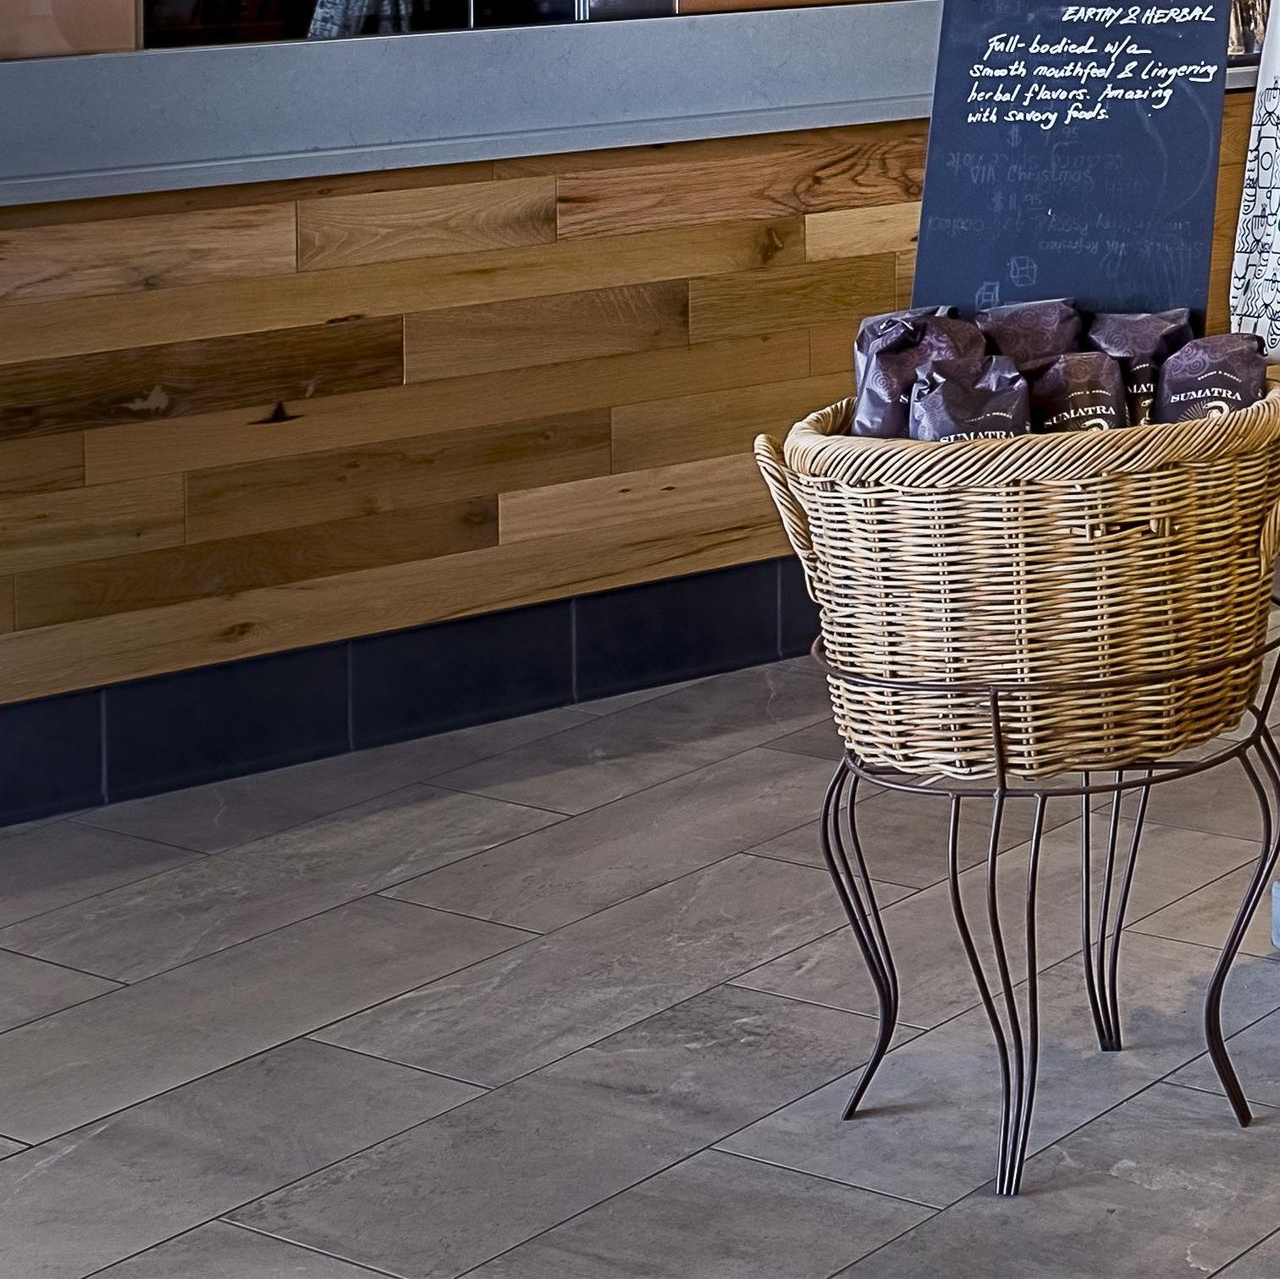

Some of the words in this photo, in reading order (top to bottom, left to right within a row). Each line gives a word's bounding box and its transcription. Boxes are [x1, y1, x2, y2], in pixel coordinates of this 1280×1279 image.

[1062, 5, 1123, 27] EARTHY
[1120, 6, 1137, 24] &
[1141, 5, 1216, 25] HERBAL
[983, 34, 1097, 61] Full-bodied
[969, 61, 1027, 77] smooth
[1034, 63, 1115, 84] mouthfeel
[1117, 61, 1138, 79] &
[1141, 60, 1218, 87] lingering
[967, 81, 1020, 103] herbal
[1023, 86, 1090, 106] flavors.
[1098, 84, 1173, 109] Amazing
[967, 107, 997, 123] with
[1004, 110, 1058, 130] savory
[1064, 102, 1109, 125] foods.
[1170, 386, 1242, 404] SUMATRA
[1044, 405, 1116, 429] SUMATRA
